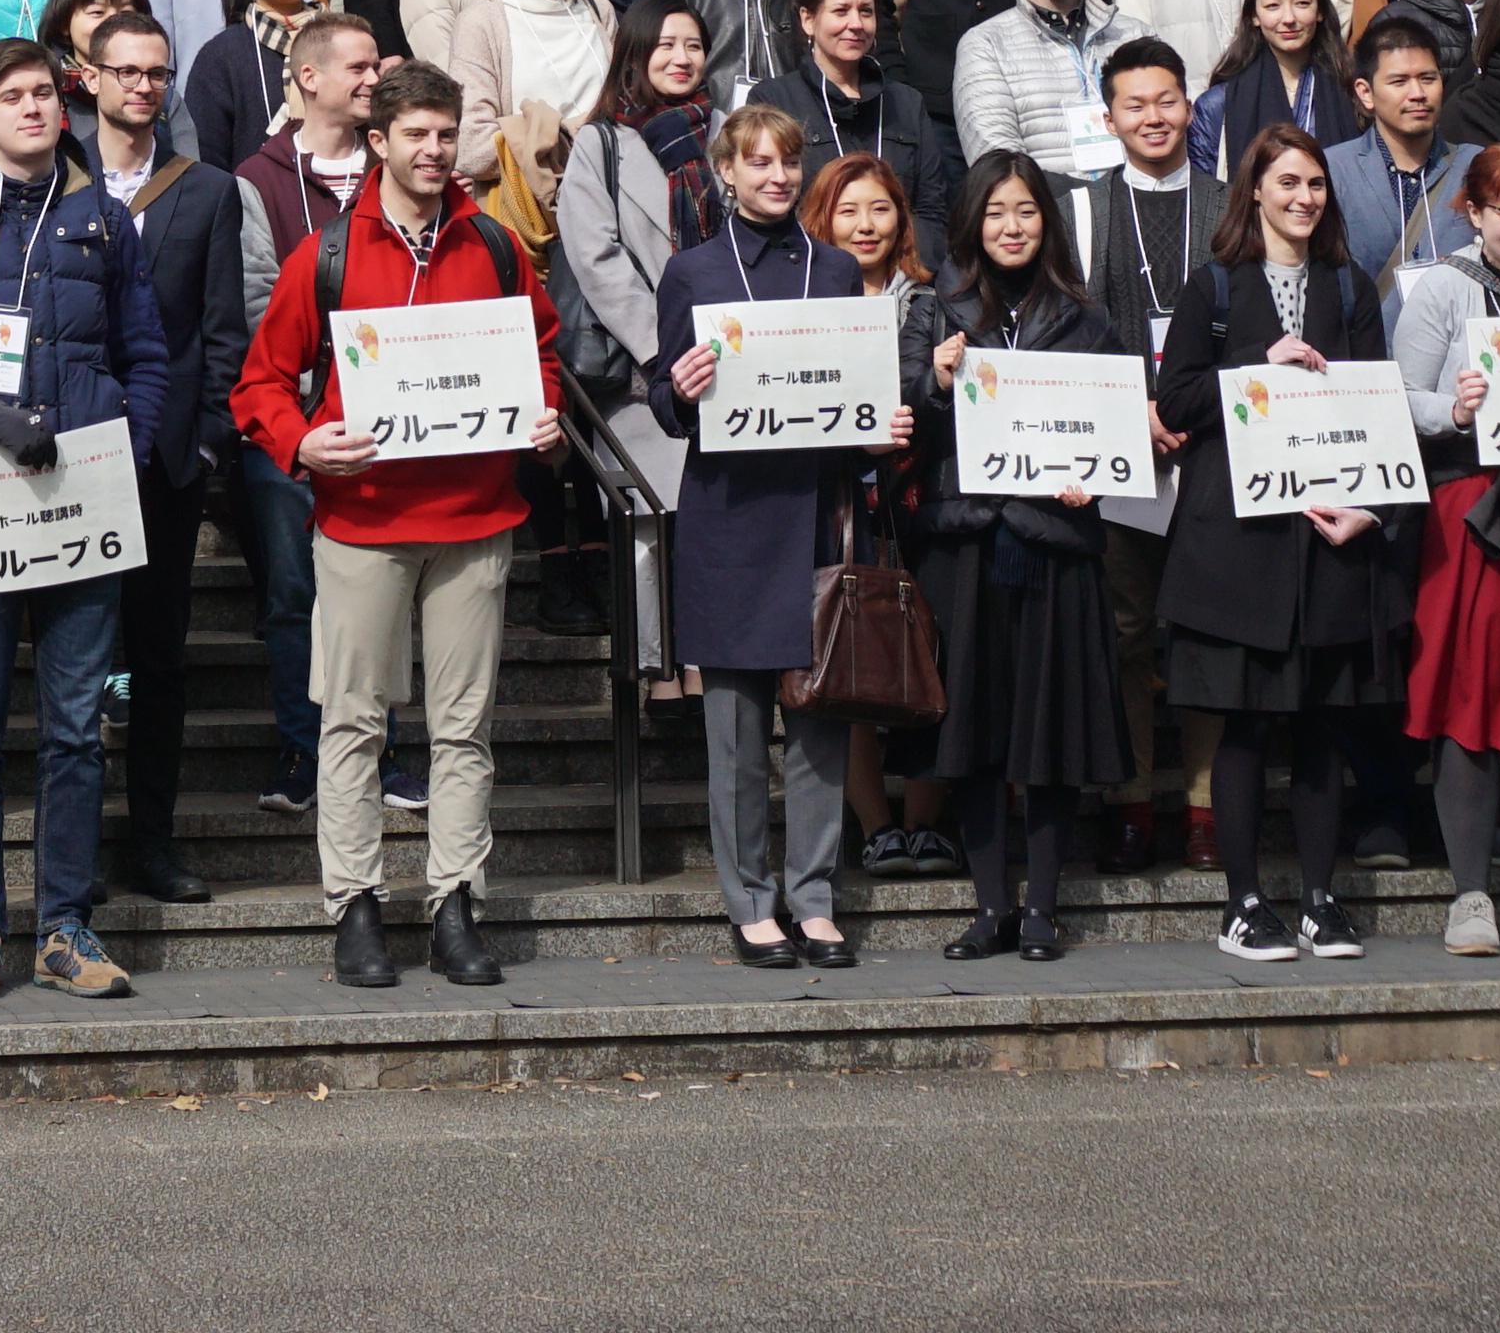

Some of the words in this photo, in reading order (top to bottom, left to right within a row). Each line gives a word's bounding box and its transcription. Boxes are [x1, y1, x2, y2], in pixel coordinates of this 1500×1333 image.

[397, 374, 481, 393] ホール聴講時
[757, 370, 841, 386] ホール聴講時
[1012, 420, 1095, 434] ホール聴講時
[1287, 430, 1367, 448] ホール聴講時
